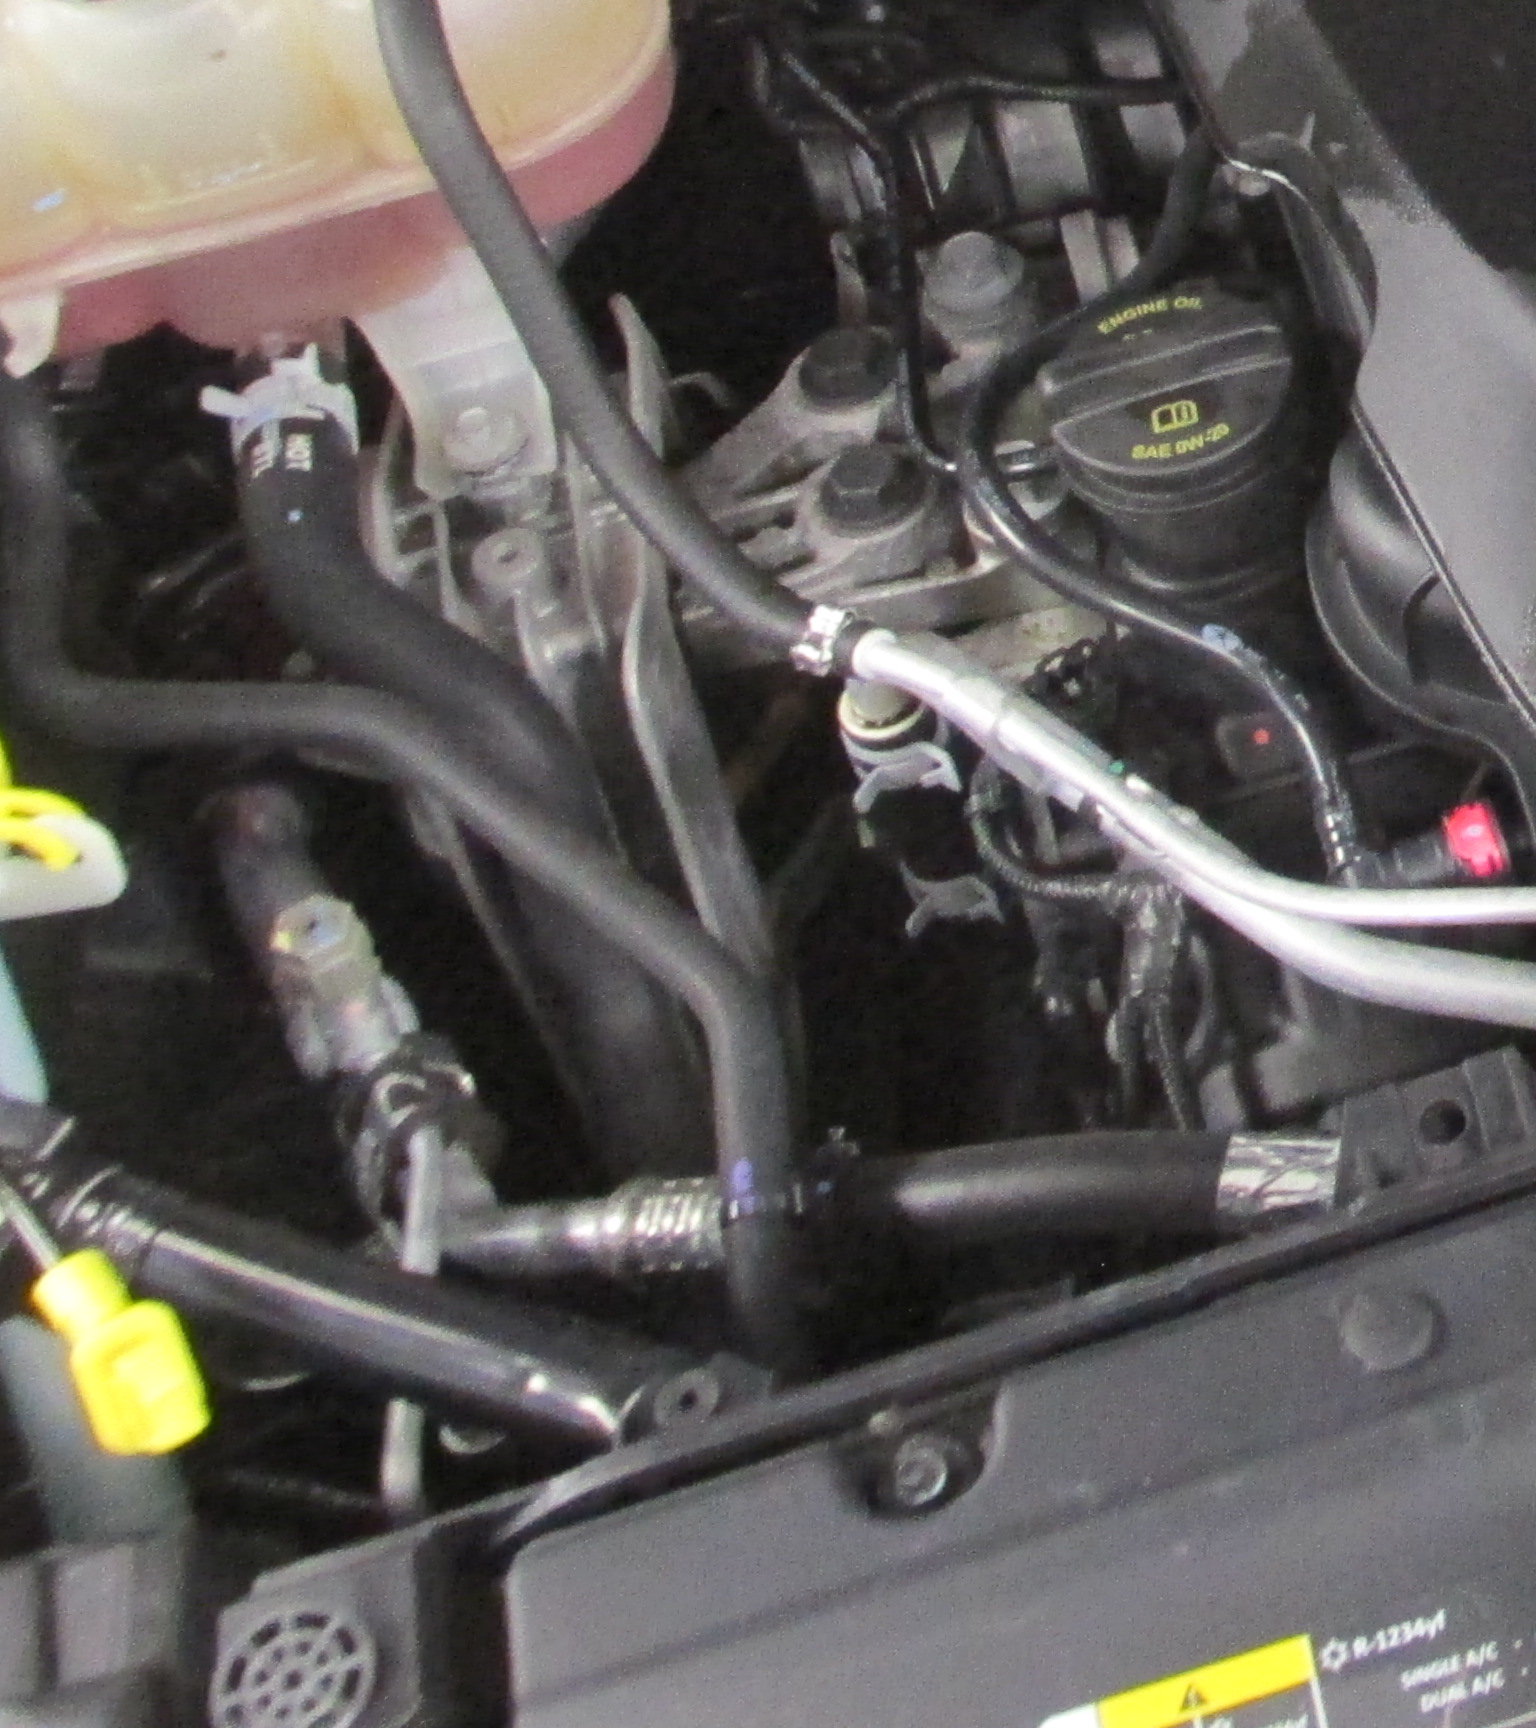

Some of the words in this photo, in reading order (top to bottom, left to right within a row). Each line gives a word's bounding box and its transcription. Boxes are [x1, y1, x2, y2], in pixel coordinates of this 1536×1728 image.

[1097, 298, 1168, 334] ENGINE
[1174, 295, 1202, 310] OIL
[1131, 443, 1173, 459] SAE
[1175, 422, 1230, 454] 0W-20
[1353, 1608, 1446, 1659] R-1234yf
[1466, 1641, 1499, 1668] A/C
[1472, 1667, 1505, 1696] A/C
